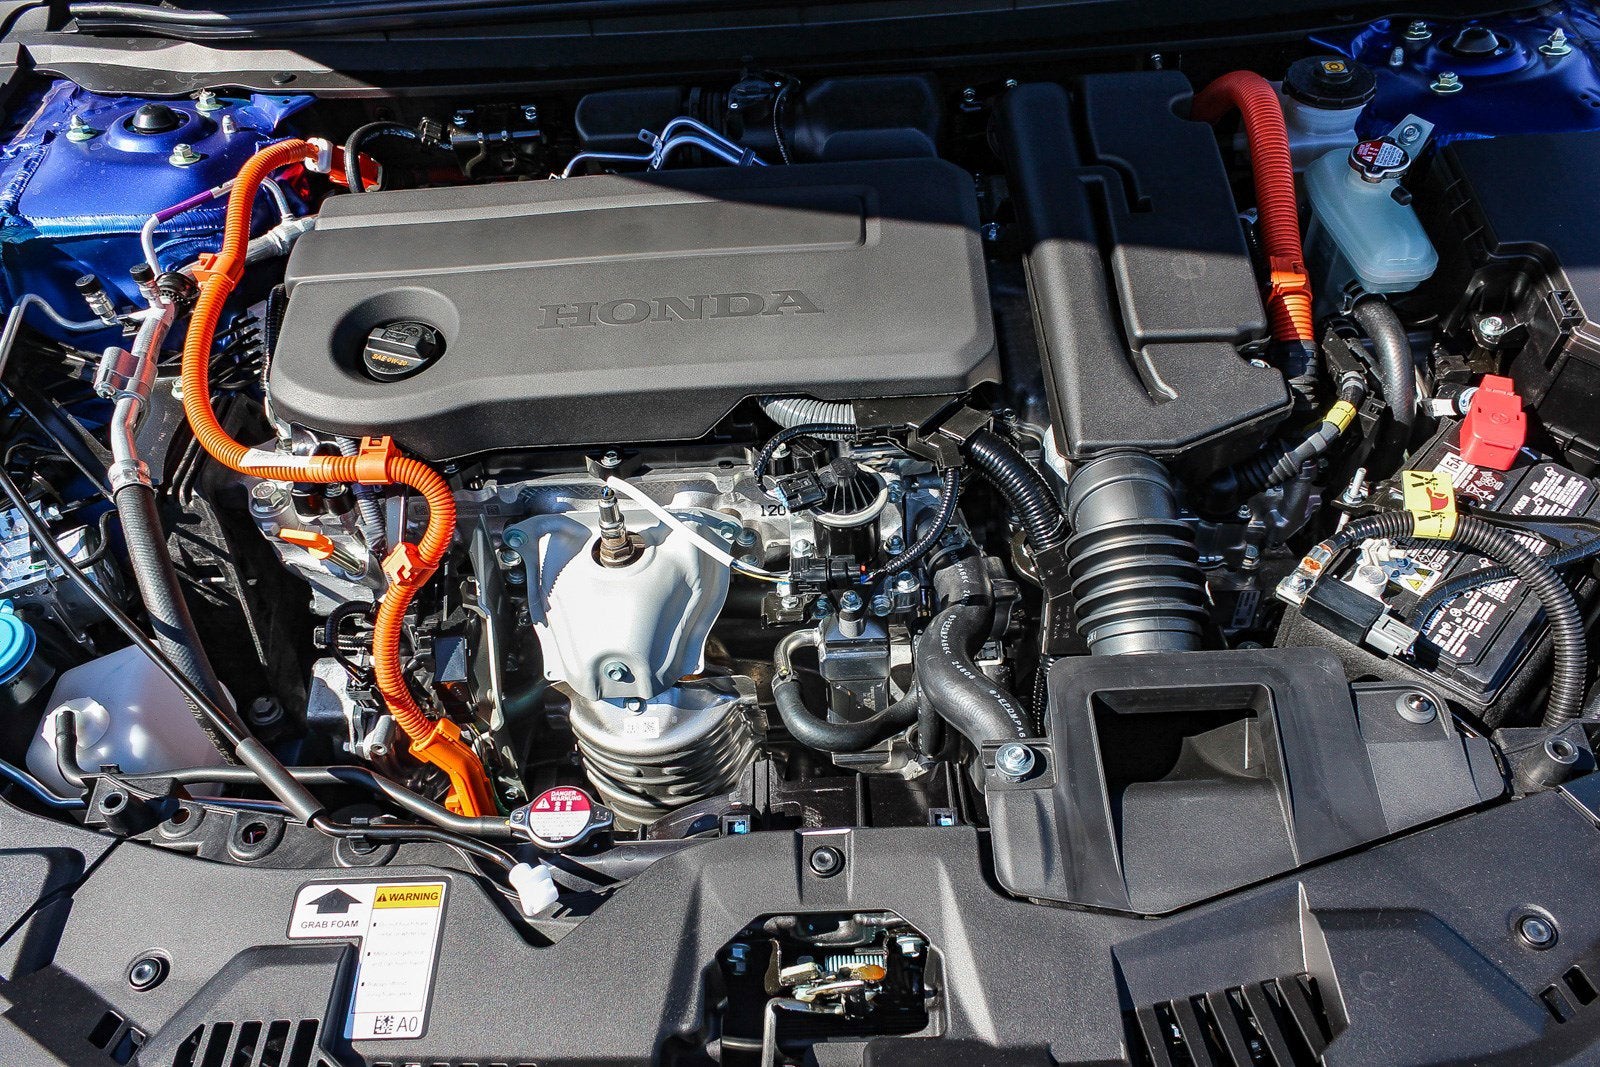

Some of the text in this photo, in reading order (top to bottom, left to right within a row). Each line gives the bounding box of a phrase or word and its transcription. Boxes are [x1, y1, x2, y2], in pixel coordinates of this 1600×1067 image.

[537, 289, 825, 330] HONDA
[372, 354, 387, 362] SAE
[760, 504, 787, 517] 120
[389, 892, 438, 901] WARNING
[301, 920, 359, 929] GRAB FOAM
[397, 1016, 418, 1032] A0
